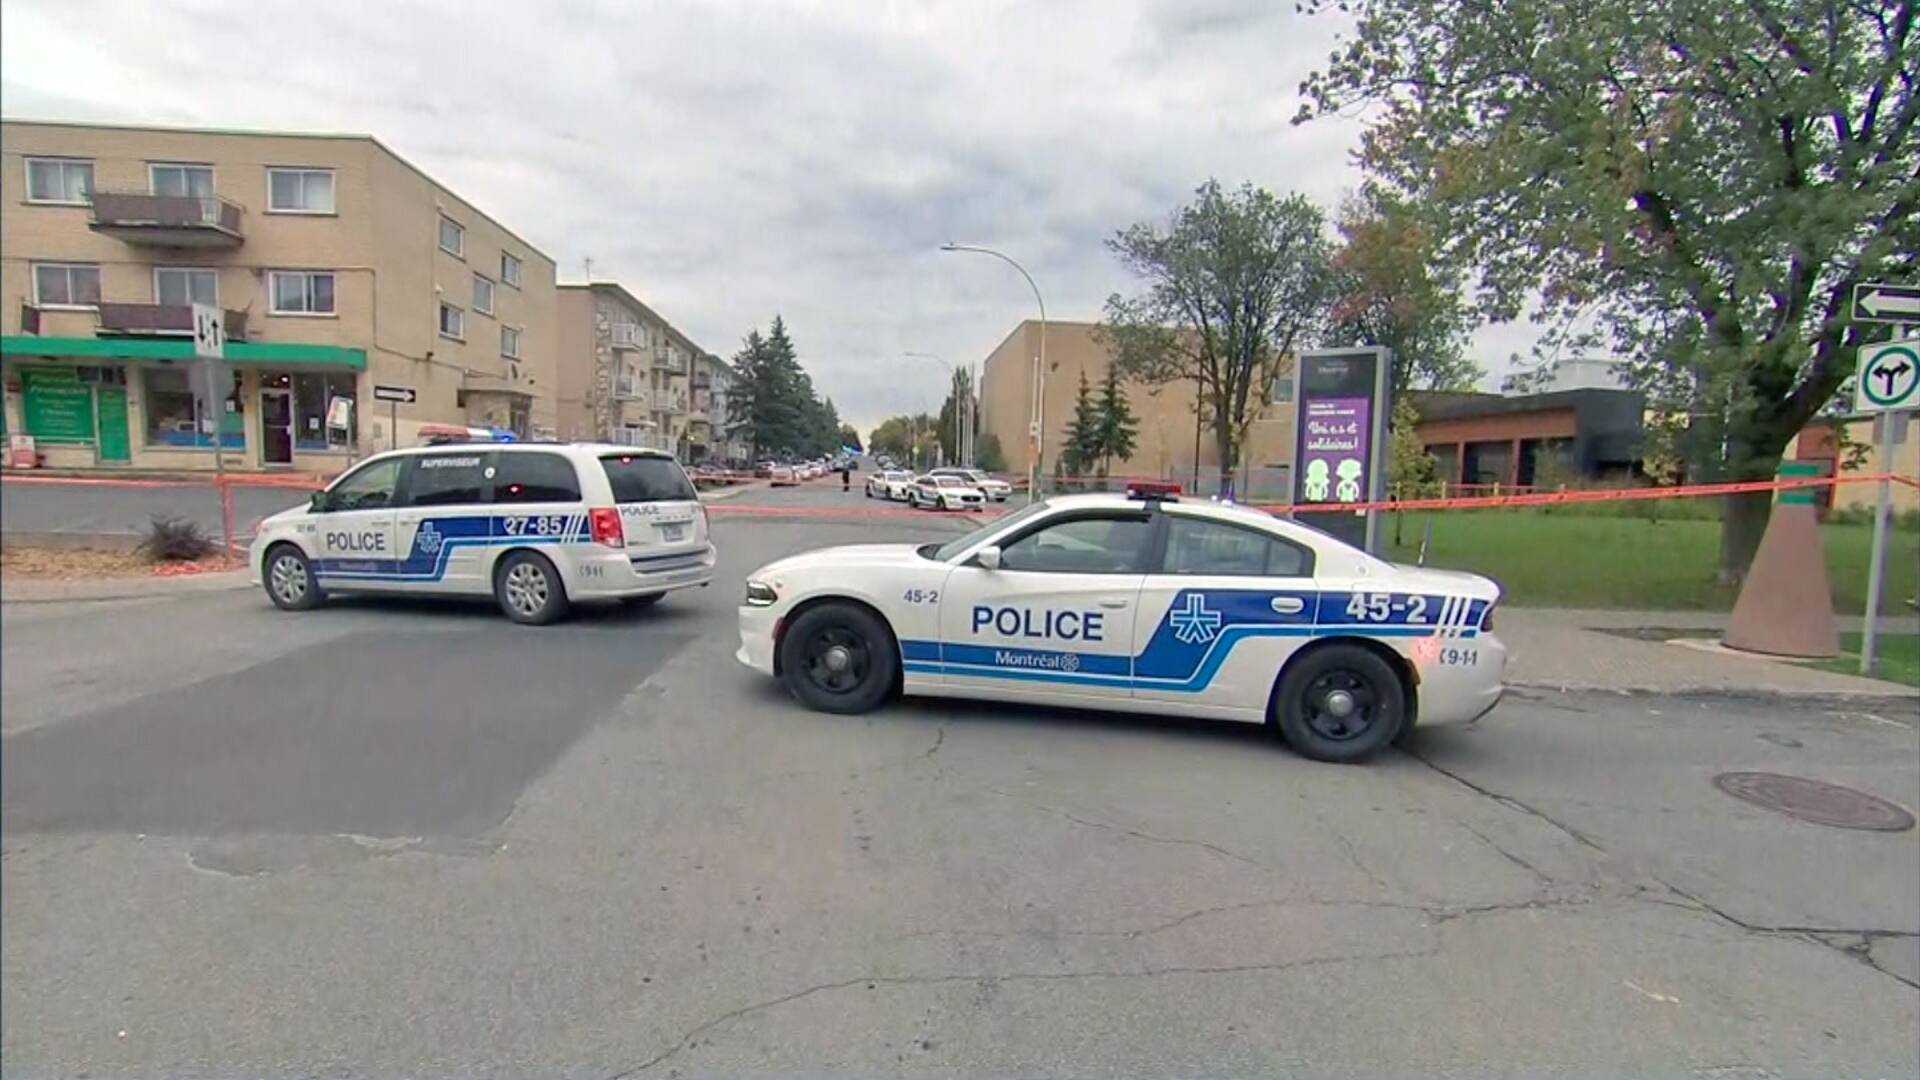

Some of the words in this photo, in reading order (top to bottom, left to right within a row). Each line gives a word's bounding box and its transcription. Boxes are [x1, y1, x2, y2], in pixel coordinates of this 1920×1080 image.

[421, 457, 480, 469] SUPERVISEUR
[621, 505, 660, 516] POLICE
[504, 517, 562, 535] 27-85
[326, 532, 387, 551] POLICE
[903, 588, 939, 603] 45-2
[1346, 592, 1427, 624] 45-2
[972, 605, 1104, 641] POLICE
[995, 650, 1060, 668] Montréal
